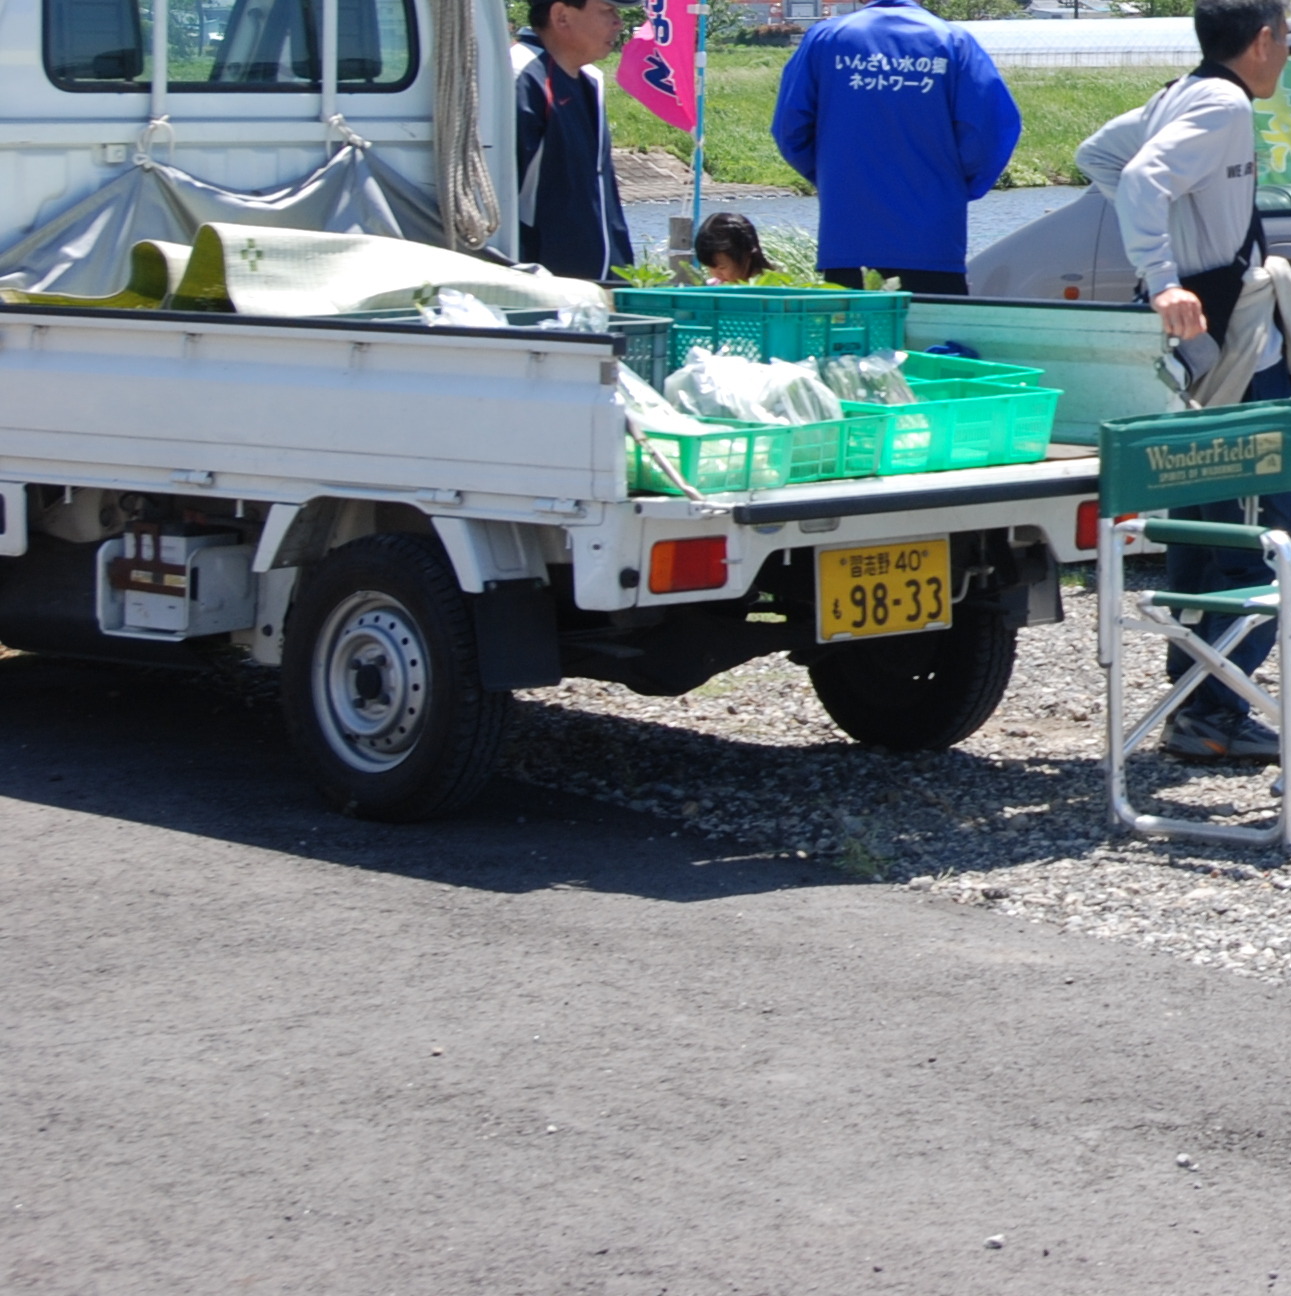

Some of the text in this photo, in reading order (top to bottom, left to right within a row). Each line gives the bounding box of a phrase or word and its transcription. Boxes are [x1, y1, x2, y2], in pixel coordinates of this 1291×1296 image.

[849, 72, 934, 93] ネットワーク
[1146, 435, 1256, 471] WonderField
[850, 550, 921, 578] 習志野 40
[832, 576, 942, 628] も 98-33
